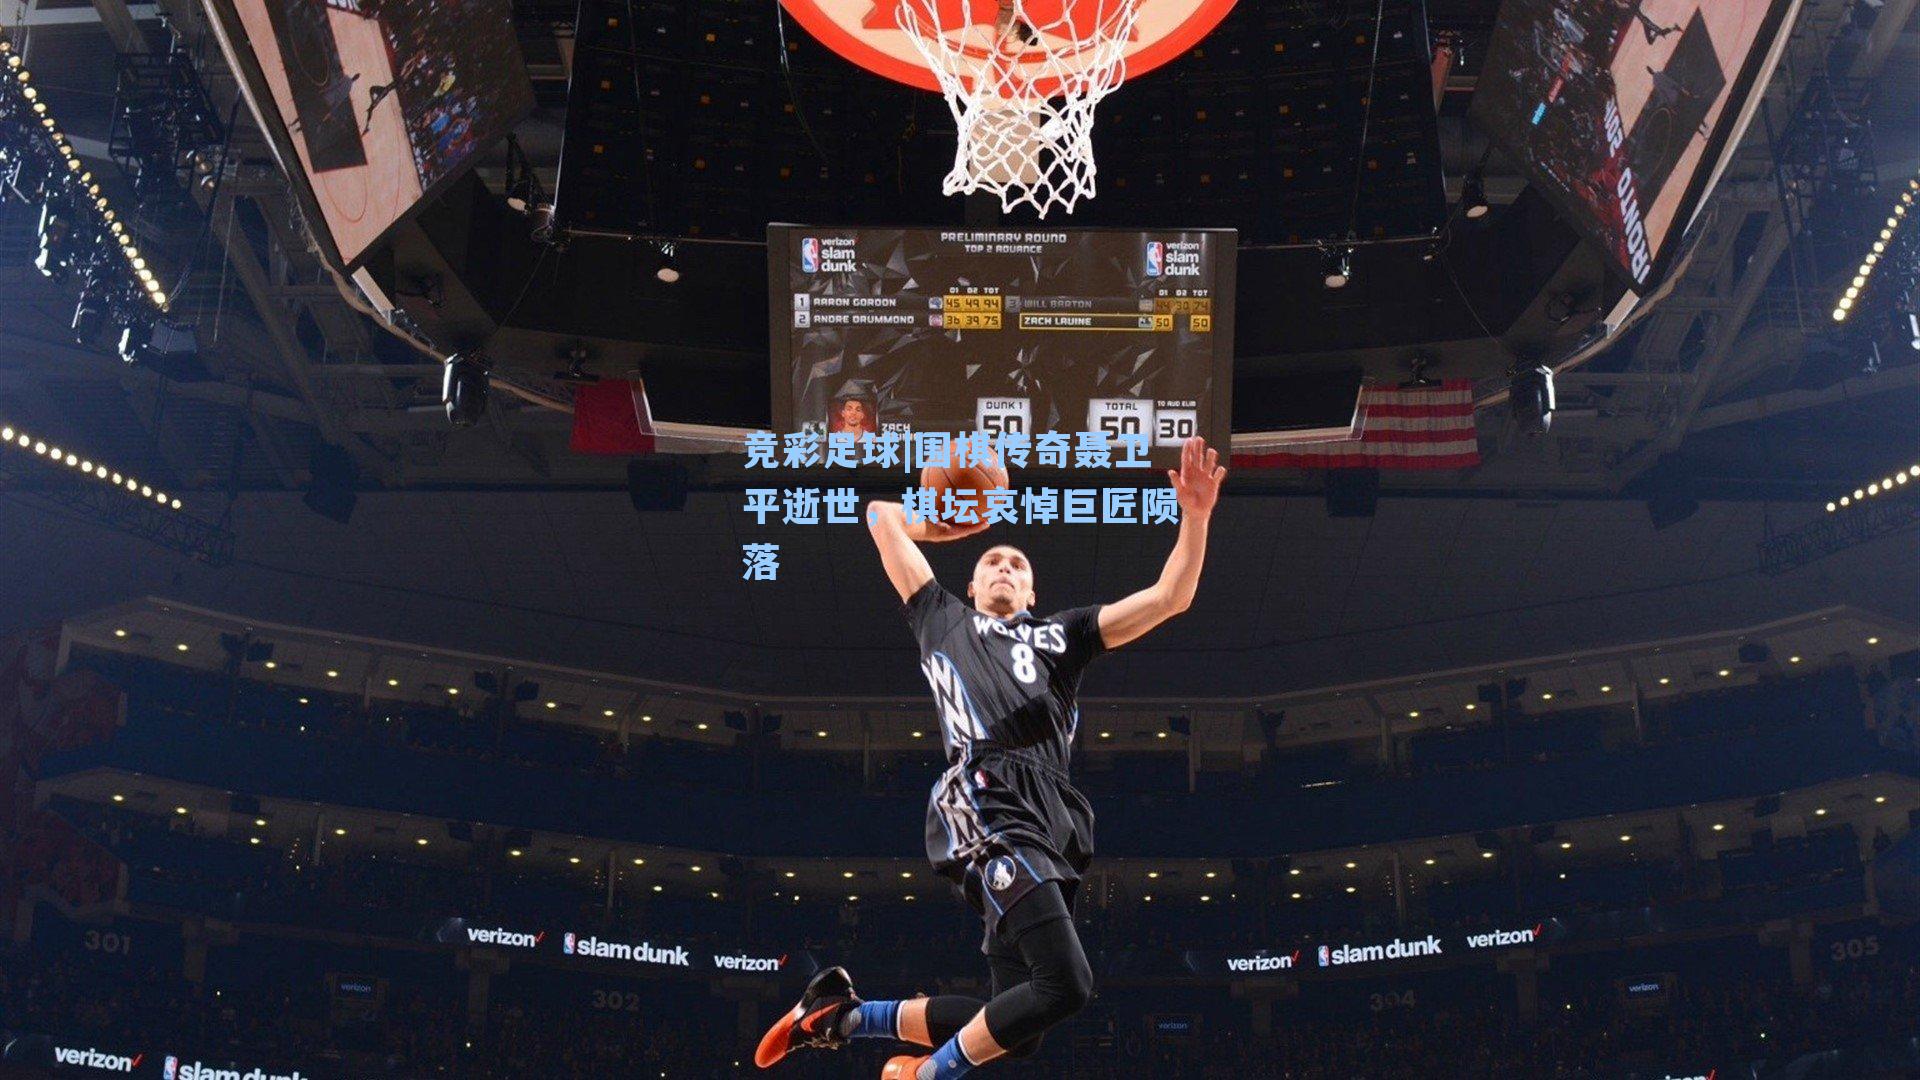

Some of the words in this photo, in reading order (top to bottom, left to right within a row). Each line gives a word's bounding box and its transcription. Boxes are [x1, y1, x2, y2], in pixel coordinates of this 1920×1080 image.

[821, 238, 855, 246] verizon
[940, 232, 1022, 243] PRELIMINARY
[1025, 233, 1067, 243] ROUND
[965, 244, 984, 253] TOP
[986, 245, 994, 253] 2
[1165, 242, 1200, 250] verizon
[821, 247, 855, 260] slam
[1165, 250, 1200, 263] slam
[821, 258, 857, 272] dunk
[1165, 263, 1200, 276] dunk
[799, 298, 805, 307] 1
[813, 298, 850, 307] AARON
[853, 298, 897, 307] GORDON
[946, 299, 961, 308] 45
[965, 299, 980, 309] 49
[983, 299, 999, 309] 94
[1024, 300, 1047, 309] WILL
[1050, 300, 1092, 309] BARTON
[798, 315, 806, 325] 2
[813, 315, 850, 324] ANDRE
[852, 315, 915, 324] DRUMMOND
[965, 315, 980, 326] 39
[984, 315, 999, 325] 75
[1024, 316, 1052, 325] ZACH
[1054, 316, 1092, 326] LAVINE
[1156, 318, 1170, 327] 50
[1193, 318, 1208, 327] 50
[986, 401, 1015, 410] DUNK
[1018, 401, 1024, 410] 1
[1105, 402, 1138, 411] TOTAL
[983, 415, 1023, 438] 50
[1100, 416, 1140, 440] 50
[1159, 418, 1193, 438] 30
[1010, 642, 1037, 684] 8
[84, 930, 132, 955] 301
[467, 927, 536, 948] verizon
[1466, 928, 1534, 949] verizon
[577, 935, 631, 960] slam
[633, 941, 690, 966] dunk
[1331, 944, 1384, 965] slam
[1385, 934, 1442, 959] dunk
[1831, 936, 1880, 962] 305
[714, 954, 779, 972] verizon
[1227, 954, 1292, 972] verizon
[341, 982, 372, 993] verizon
[1628, 982, 1659, 993] verizon
[591, 990, 640, 1012] 302
[55, 1046, 132, 1073] verizon
